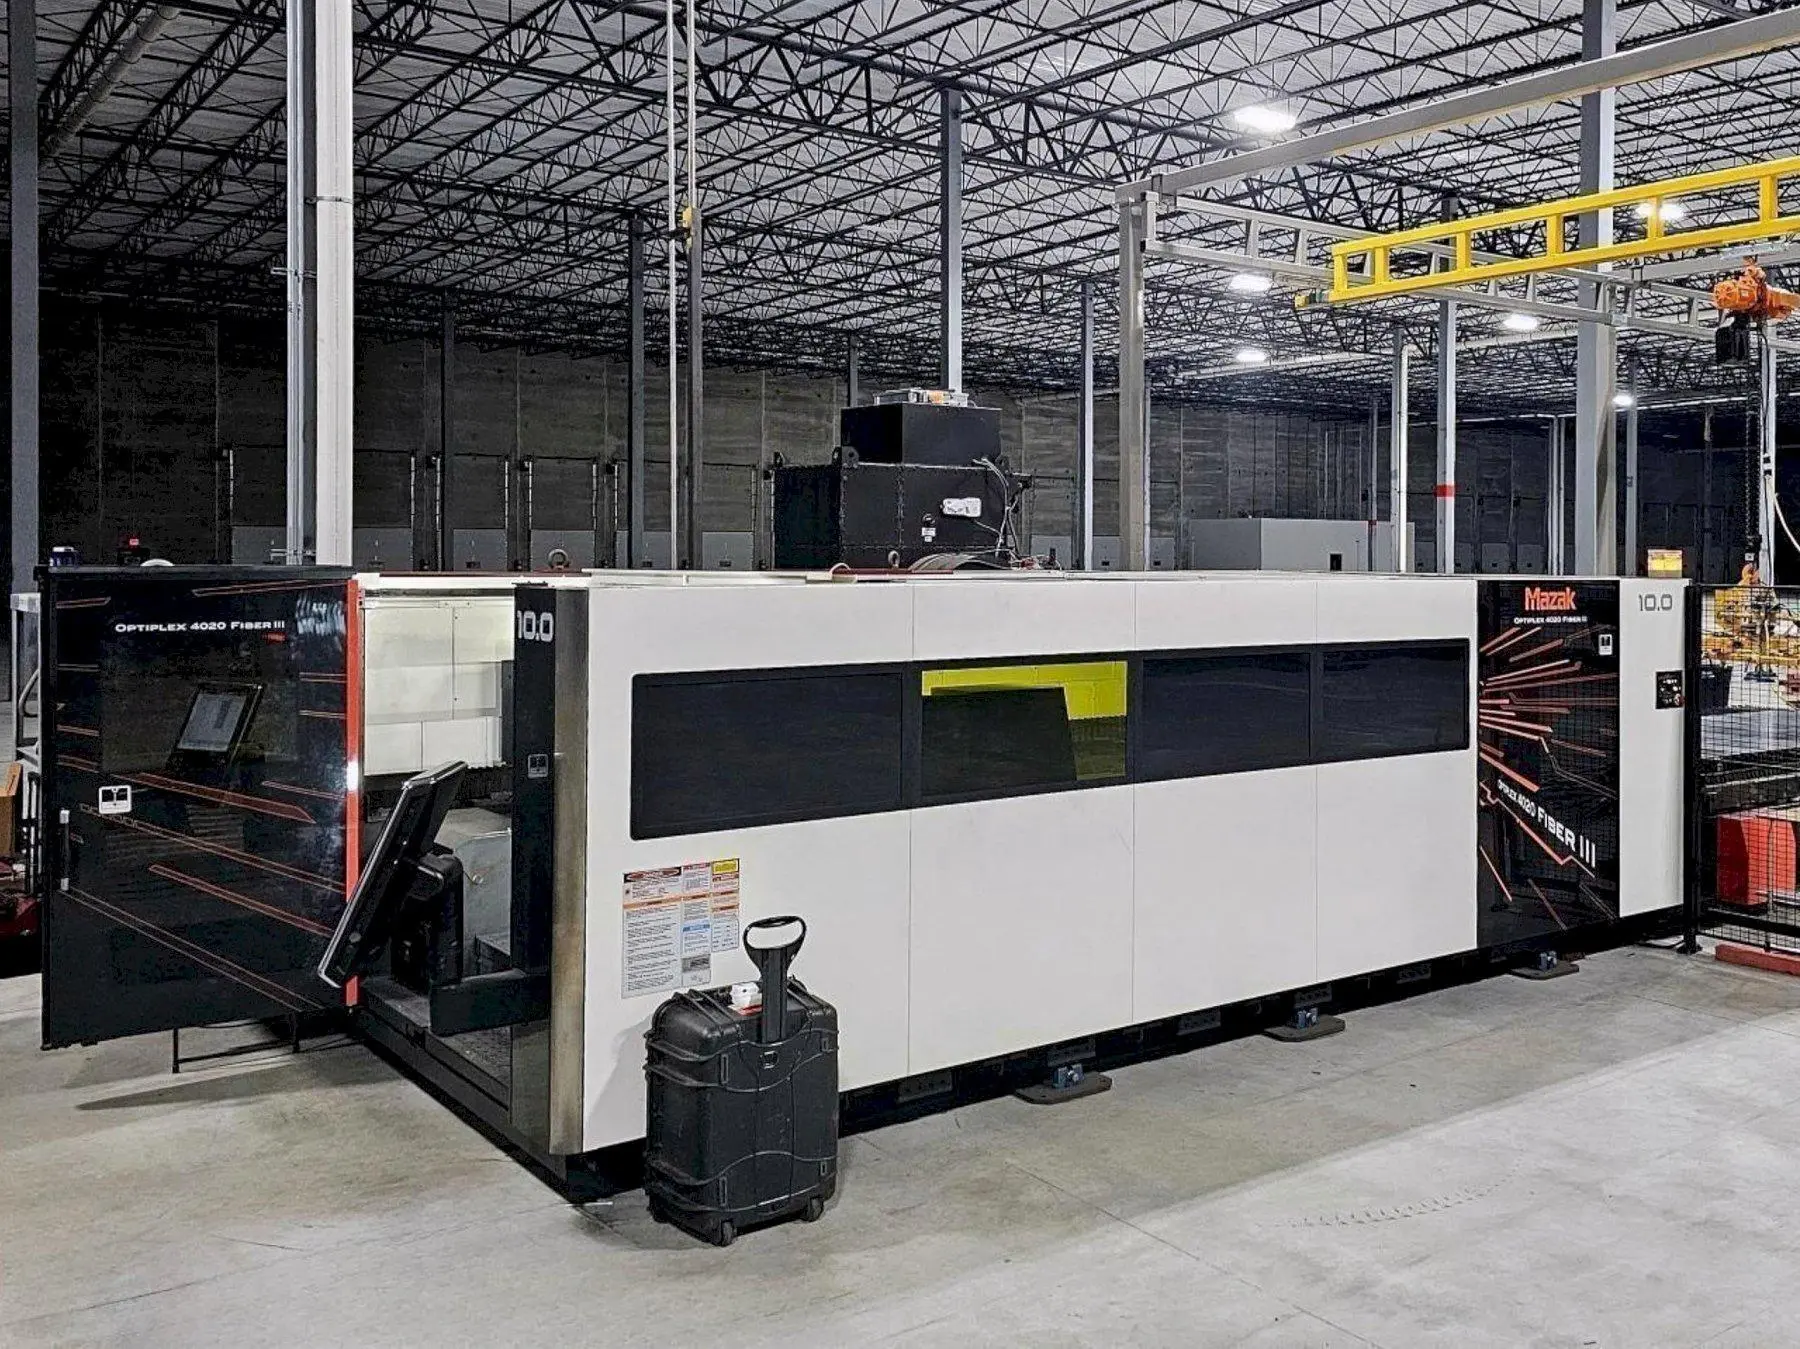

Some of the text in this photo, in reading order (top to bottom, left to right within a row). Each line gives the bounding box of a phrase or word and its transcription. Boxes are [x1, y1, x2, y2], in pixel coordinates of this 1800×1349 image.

[1525, 586, 1577, 611] Mazak
[1638, 593, 1672, 611] 10.0
[115, 619, 286, 633] OPTIPLEX 4020 FIBER III
[517, 610, 554, 643] 10.0
[1537, 806, 1576, 852] FIBER
[1580, 834, 1596, 868] III
